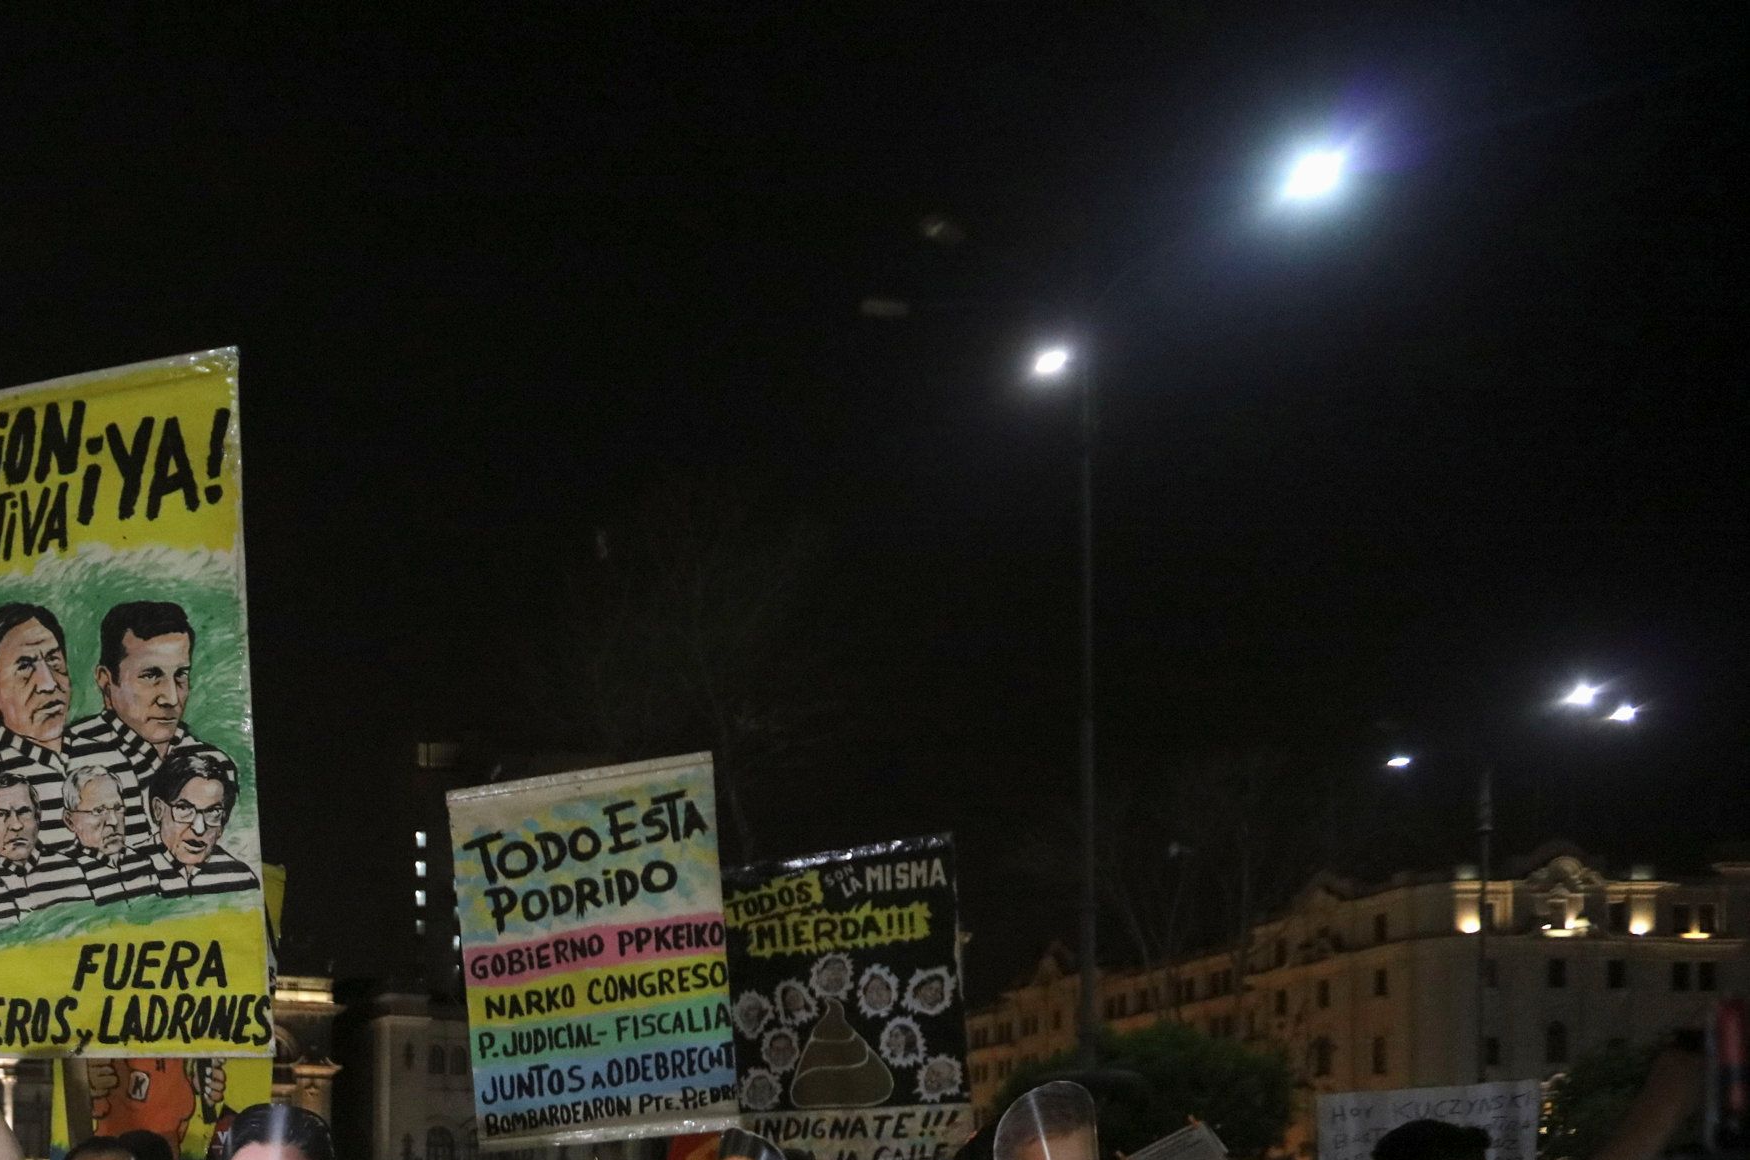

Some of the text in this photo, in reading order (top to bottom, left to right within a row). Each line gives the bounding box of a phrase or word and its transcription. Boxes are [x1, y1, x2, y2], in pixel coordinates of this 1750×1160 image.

[463, 789, 708, 885] TODO ESTA
[865, 859, 947, 893] MISMA
[731, 882, 814, 920] TODOS
[72, 940, 227, 991] FUERA
[485, 961, 728, 1019] NARKO CONGRESO
[98, 993, 272, 1046] LADRONES
[616, 1003, 732, 1042] FISCALIA
[481, 1063, 585, 1105] JUNTOS
[485, 1095, 631, 1137] BOMBARDEARON
[753, 1112, 915, 1142] INDIGNATE
